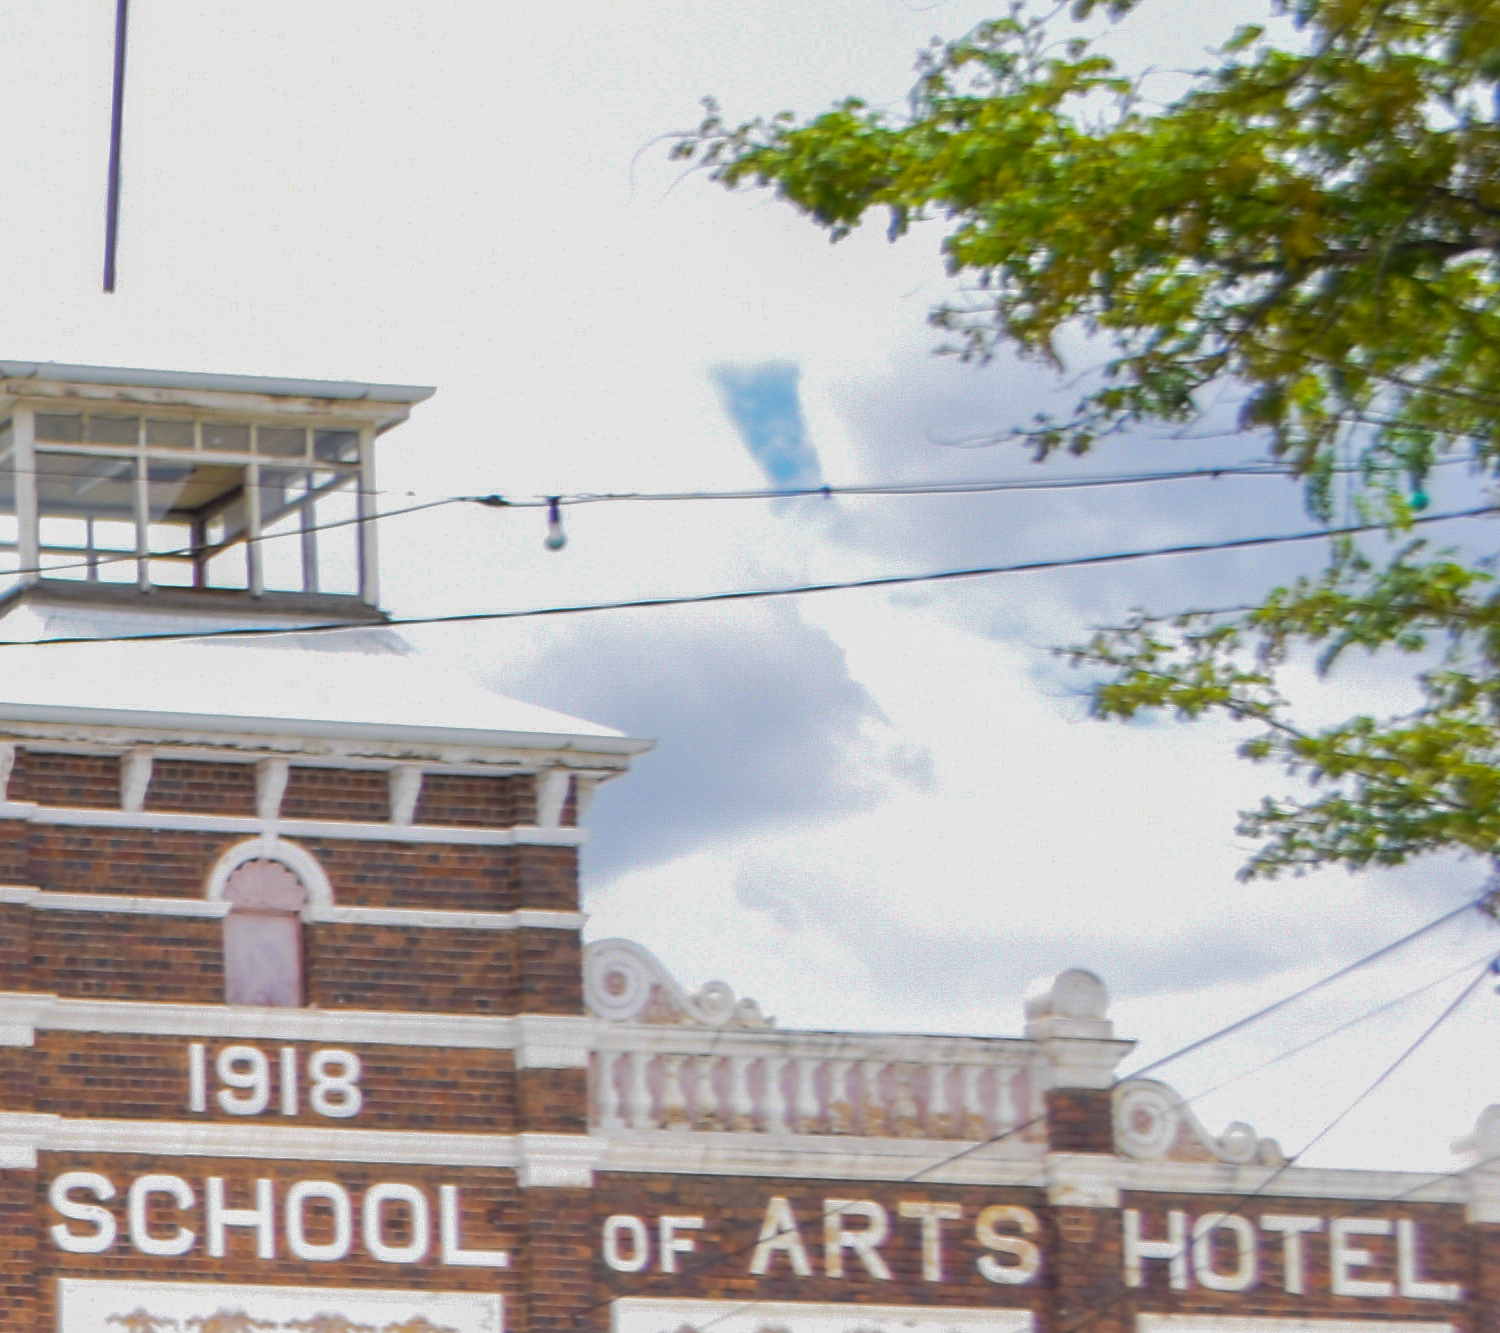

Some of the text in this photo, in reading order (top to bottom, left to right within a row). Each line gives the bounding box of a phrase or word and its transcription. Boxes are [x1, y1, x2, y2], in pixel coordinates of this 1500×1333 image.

[189, 1043, 364, 1119] 1918
[49, 1171, 1462, 1300] SCHOOL OF ARTS HOTEL
